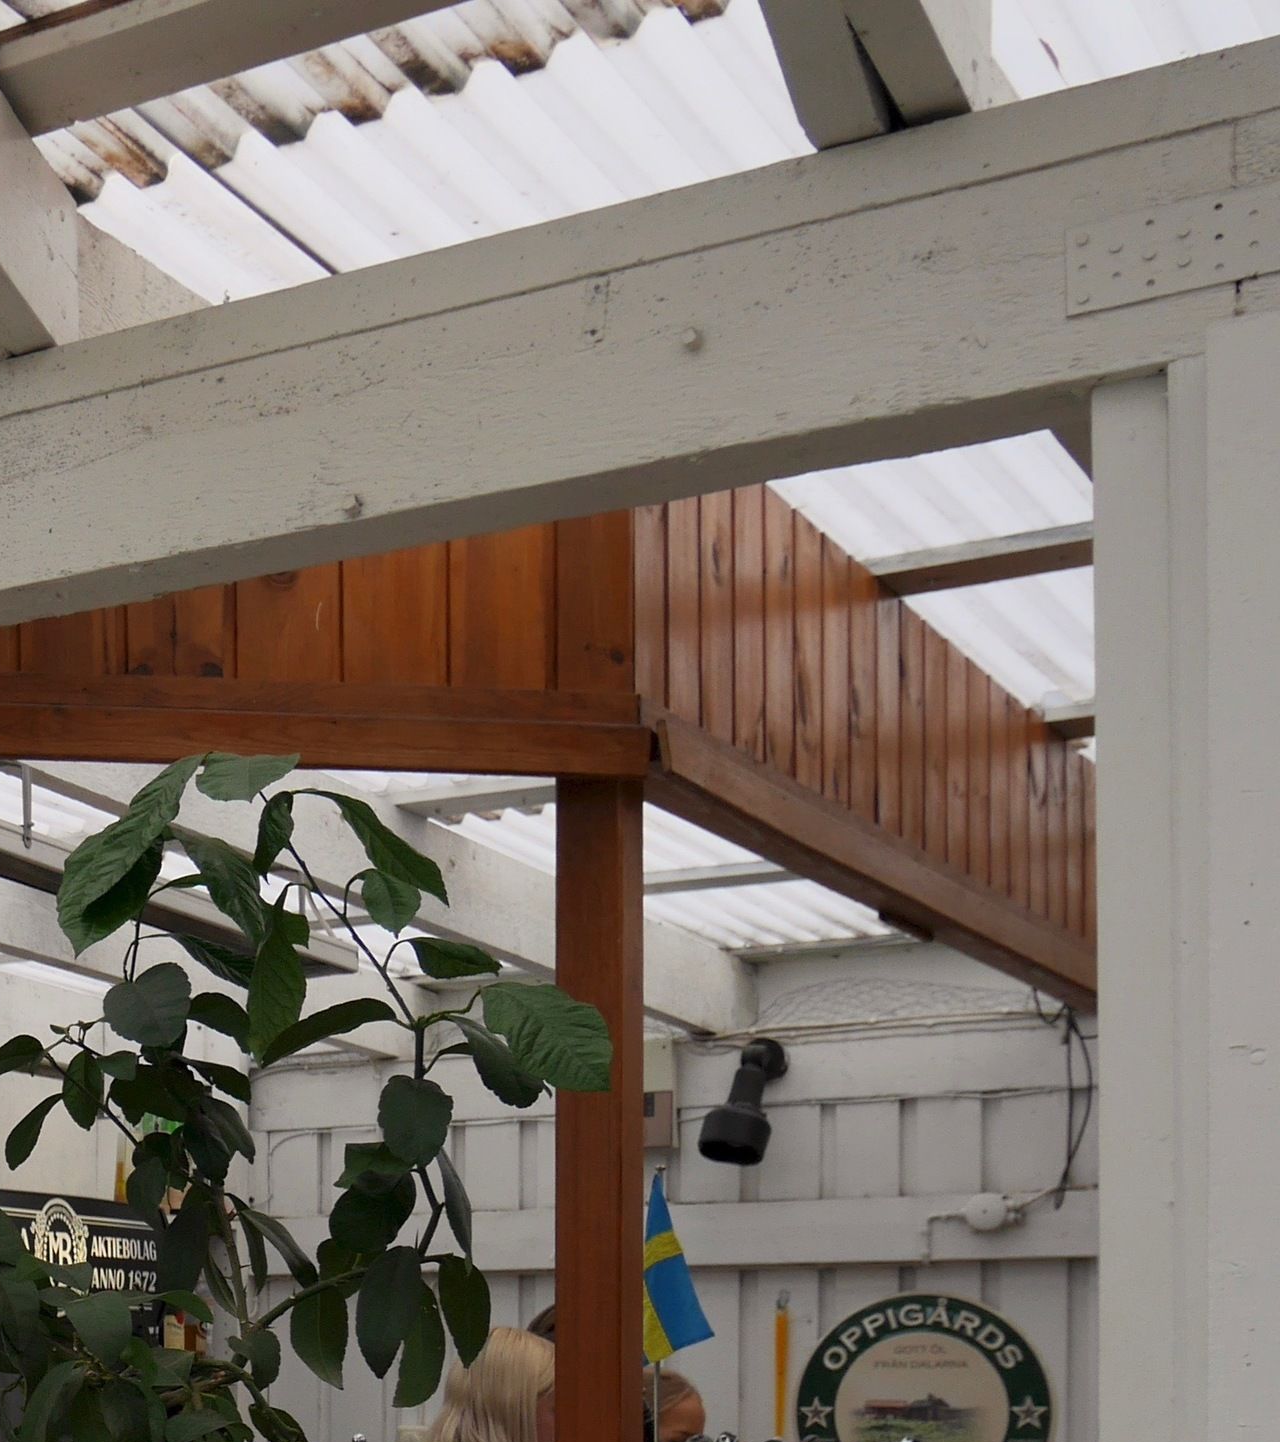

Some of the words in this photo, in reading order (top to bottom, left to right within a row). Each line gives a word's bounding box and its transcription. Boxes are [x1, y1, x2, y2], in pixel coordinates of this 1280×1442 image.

[91, 1236, 157, 1262] AKTIEBOLAG
[91, 1267, 125, 1291] ANNO
[128, 1269, 157, 1292] 1872
[823, 1298, 1024, 1371] OPPIGÅRDS
